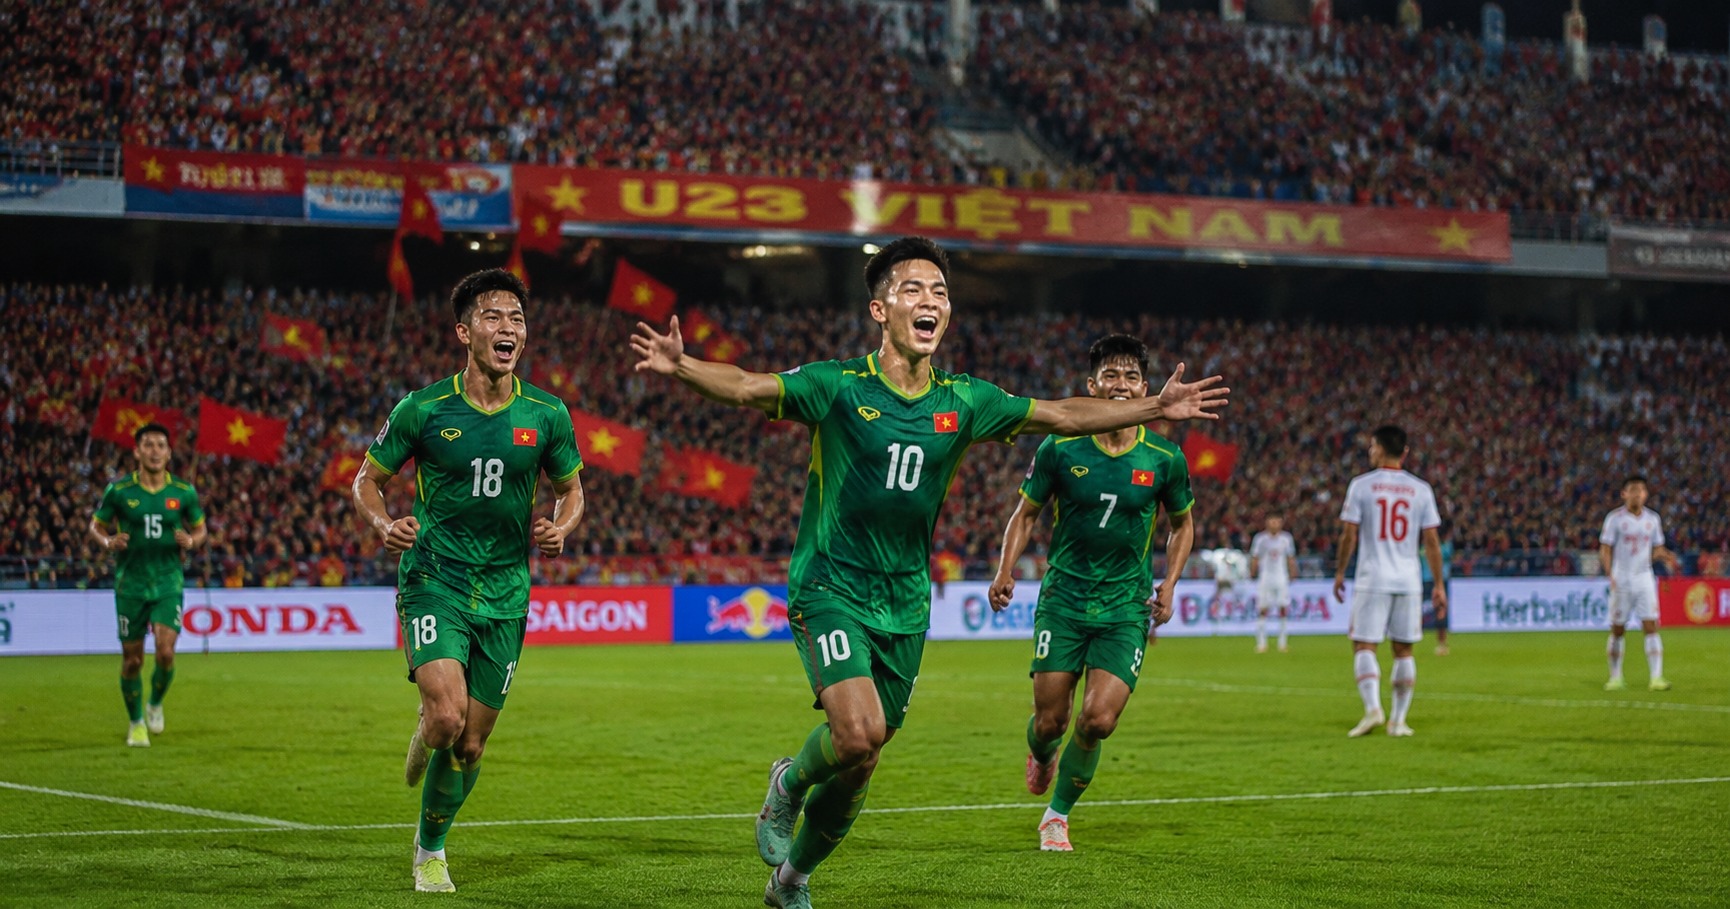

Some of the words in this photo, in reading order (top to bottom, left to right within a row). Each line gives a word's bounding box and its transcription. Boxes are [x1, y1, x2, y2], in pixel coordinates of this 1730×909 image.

[619, 179, 807, 222] U23
[843, 188, 1090, 239] VIỆT
[1127, 205, 1344, 247] NAM
[471, 457, 504, 498] 18
[885, 442, 924, 492] 10
[143, 513, 164, 540] 15
[1099, 493, 1118, 528] 7
[1375, 497, 1410, 543] 16
[180, 605, 361, 635] ONDA
[411, 614, 438, 651] 18
[527, 600, 648, 632] SAIGON
[817, 629, 852, 667] 10
